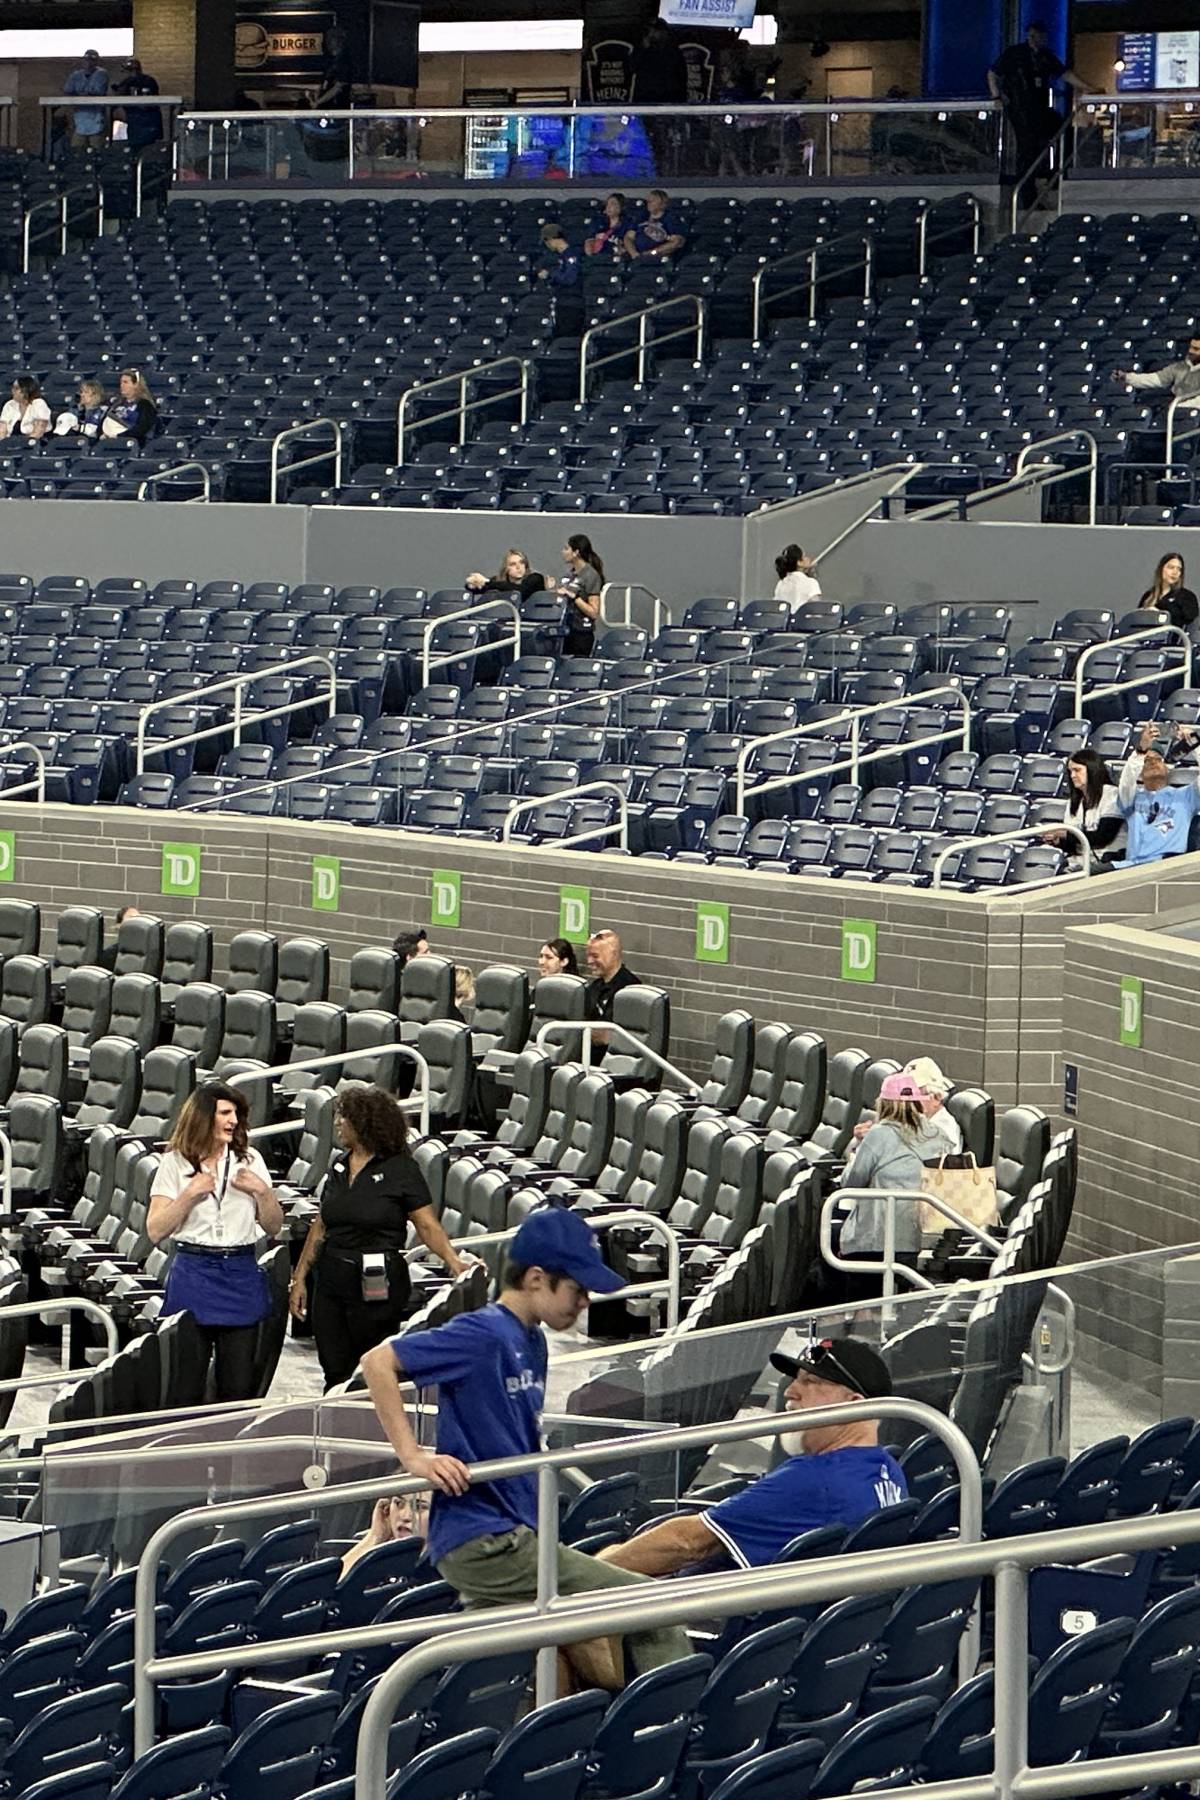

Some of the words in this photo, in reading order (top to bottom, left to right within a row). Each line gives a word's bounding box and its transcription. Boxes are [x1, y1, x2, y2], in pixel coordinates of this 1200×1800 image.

[701, 0, 736, 13] ASSIST
[272, 38, 317, 50] BURGER
[597, 87, 628, 101] HEINZ
[165, 853, 196, 886] TD
[314, 867, 336, 900] TD
[434, 882, 457, 915] TD
[562, 898, 585, 932] TD
[699, 915, 725, 951] TD
[845, 932, 872, 969] TD
[1074, 1615, 1085, 1630] 5
